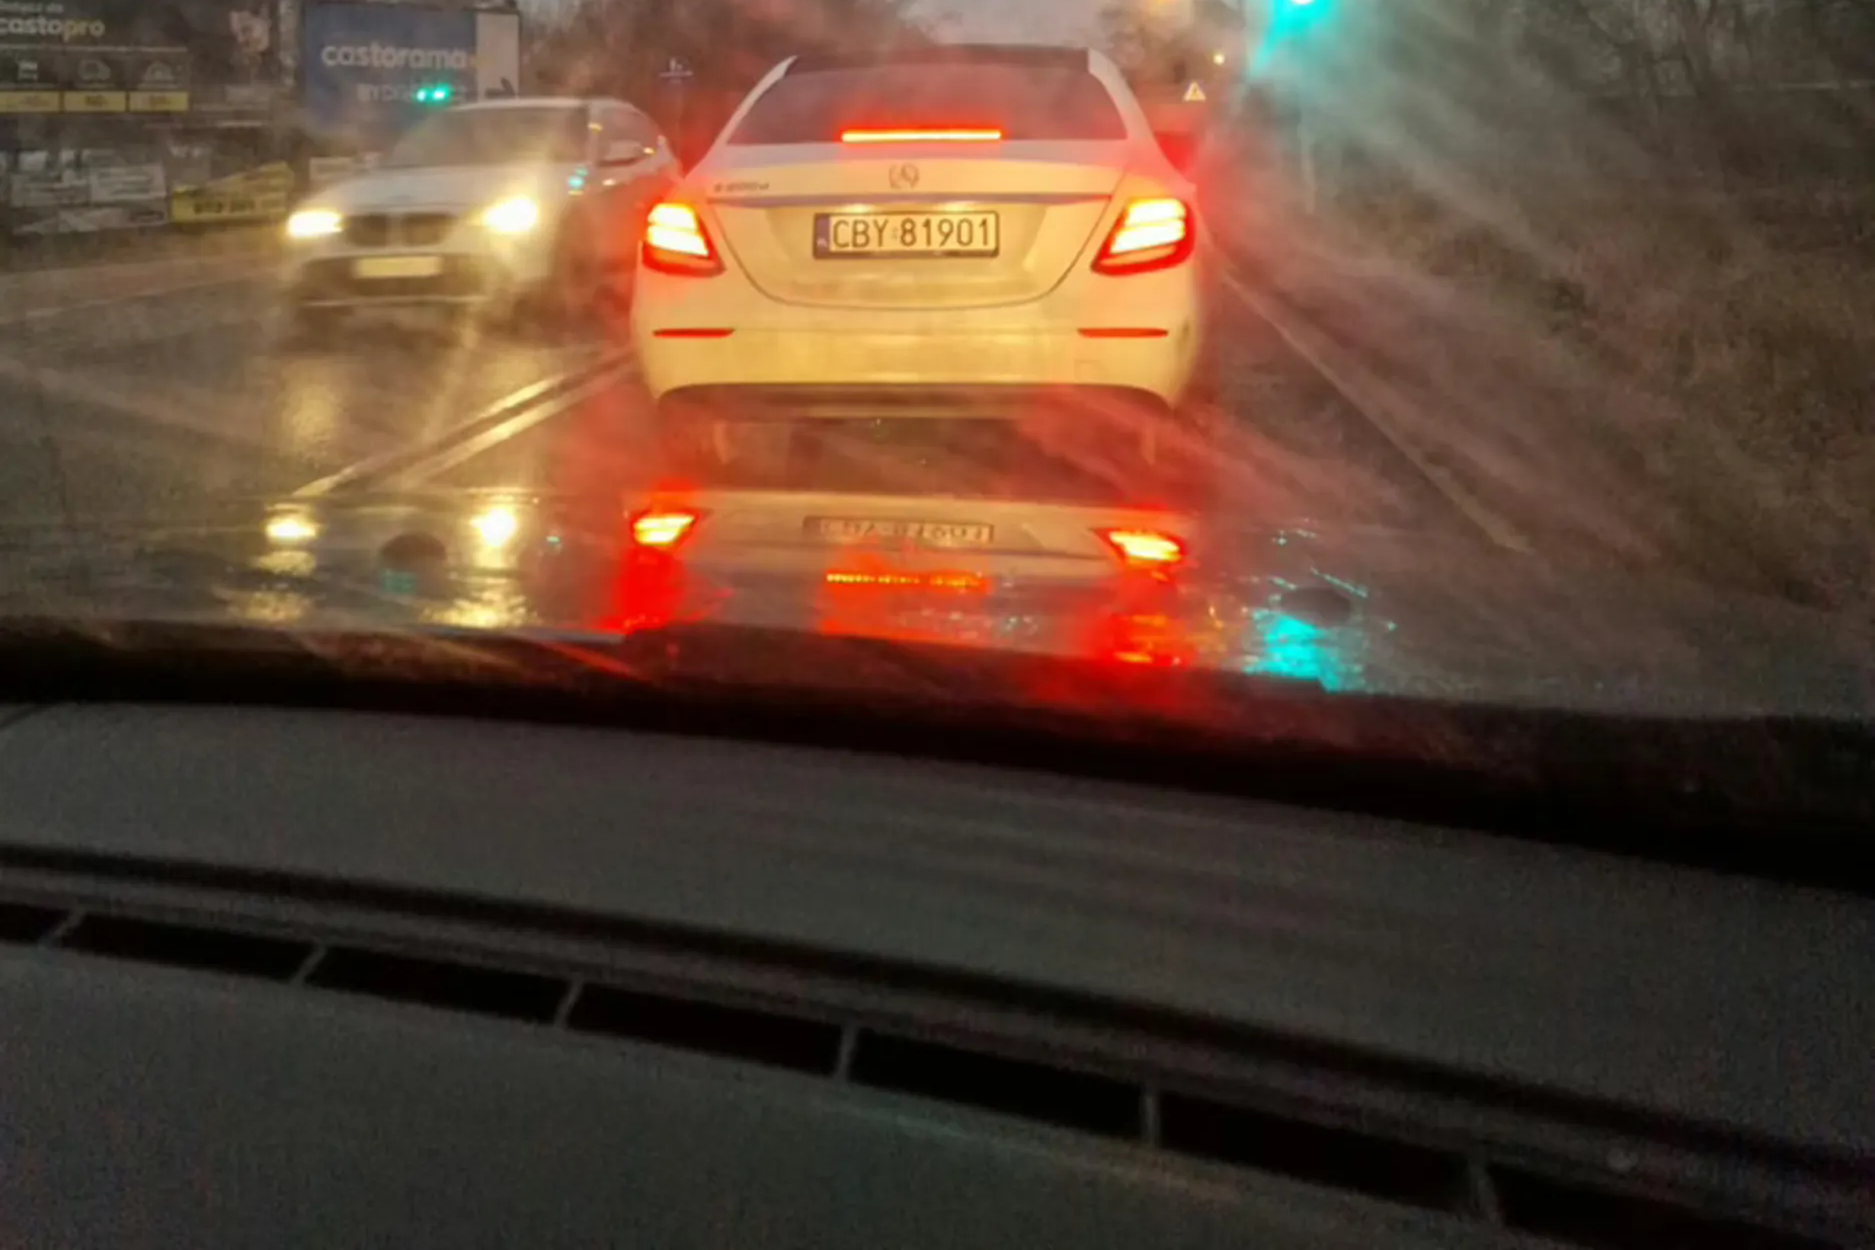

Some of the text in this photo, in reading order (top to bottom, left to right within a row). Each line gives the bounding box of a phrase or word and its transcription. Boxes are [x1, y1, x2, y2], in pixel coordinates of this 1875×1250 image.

[321, 42, 468, 70] castorama
[832, 217, 991, 248] CBY 81901
